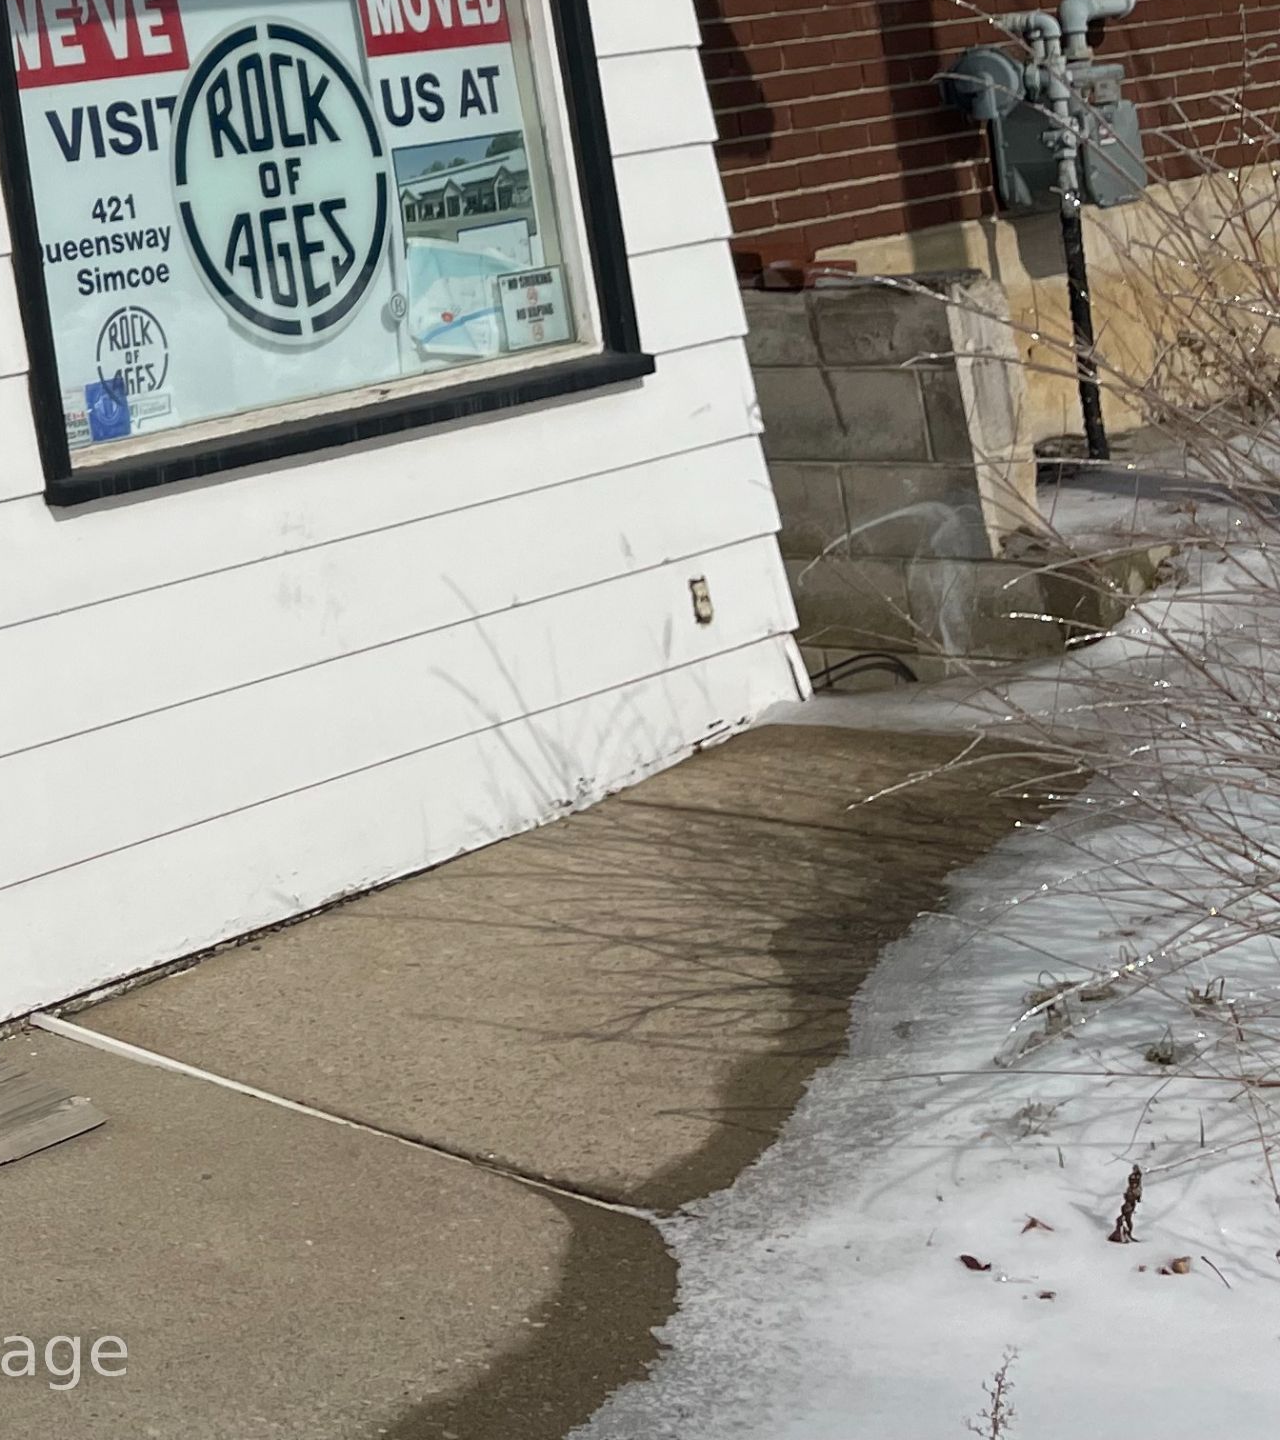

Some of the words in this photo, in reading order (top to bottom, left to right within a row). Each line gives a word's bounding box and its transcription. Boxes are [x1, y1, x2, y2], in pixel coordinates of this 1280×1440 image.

[206, 52, 341, 158] ROCK
[380, 73, 445, 127] US
[460, 65, 500, 118] AT
[258, 158, 301, 198] OF
[92, 193, 136, 223] 421
[40, 225, 171, 265] ueensway
[224, 197, 356, 308] AGES
[77, 263, 170, 296] Simcoe
[108, 314, 154, 351] ROCK
[125, 349, 139, 364] OF
